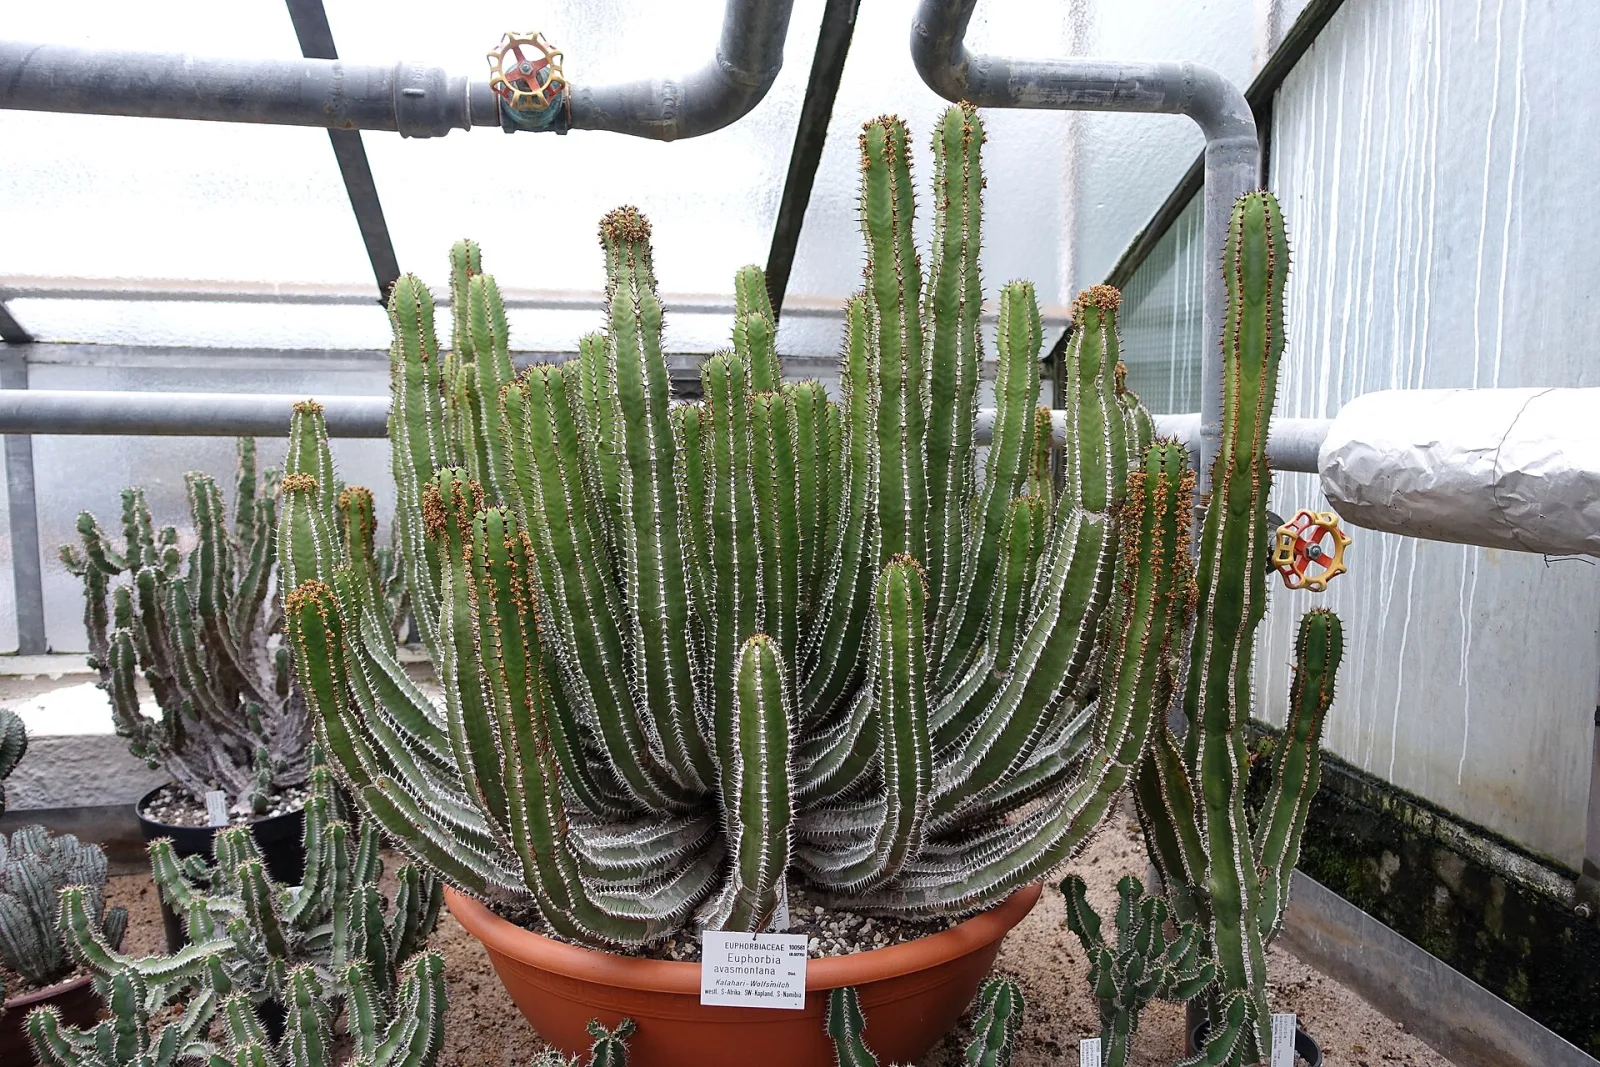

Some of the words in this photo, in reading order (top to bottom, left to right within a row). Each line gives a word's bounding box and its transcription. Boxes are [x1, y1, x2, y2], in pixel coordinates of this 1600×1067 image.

[725, 942, 785, 951] EUPHORBIACEAE
[727, 953, 781, 965] Euphorbia
[714, 965, 775, 975] avasmontana
[716, 979, 789, 988] Kalahari-Wolfsmilch
